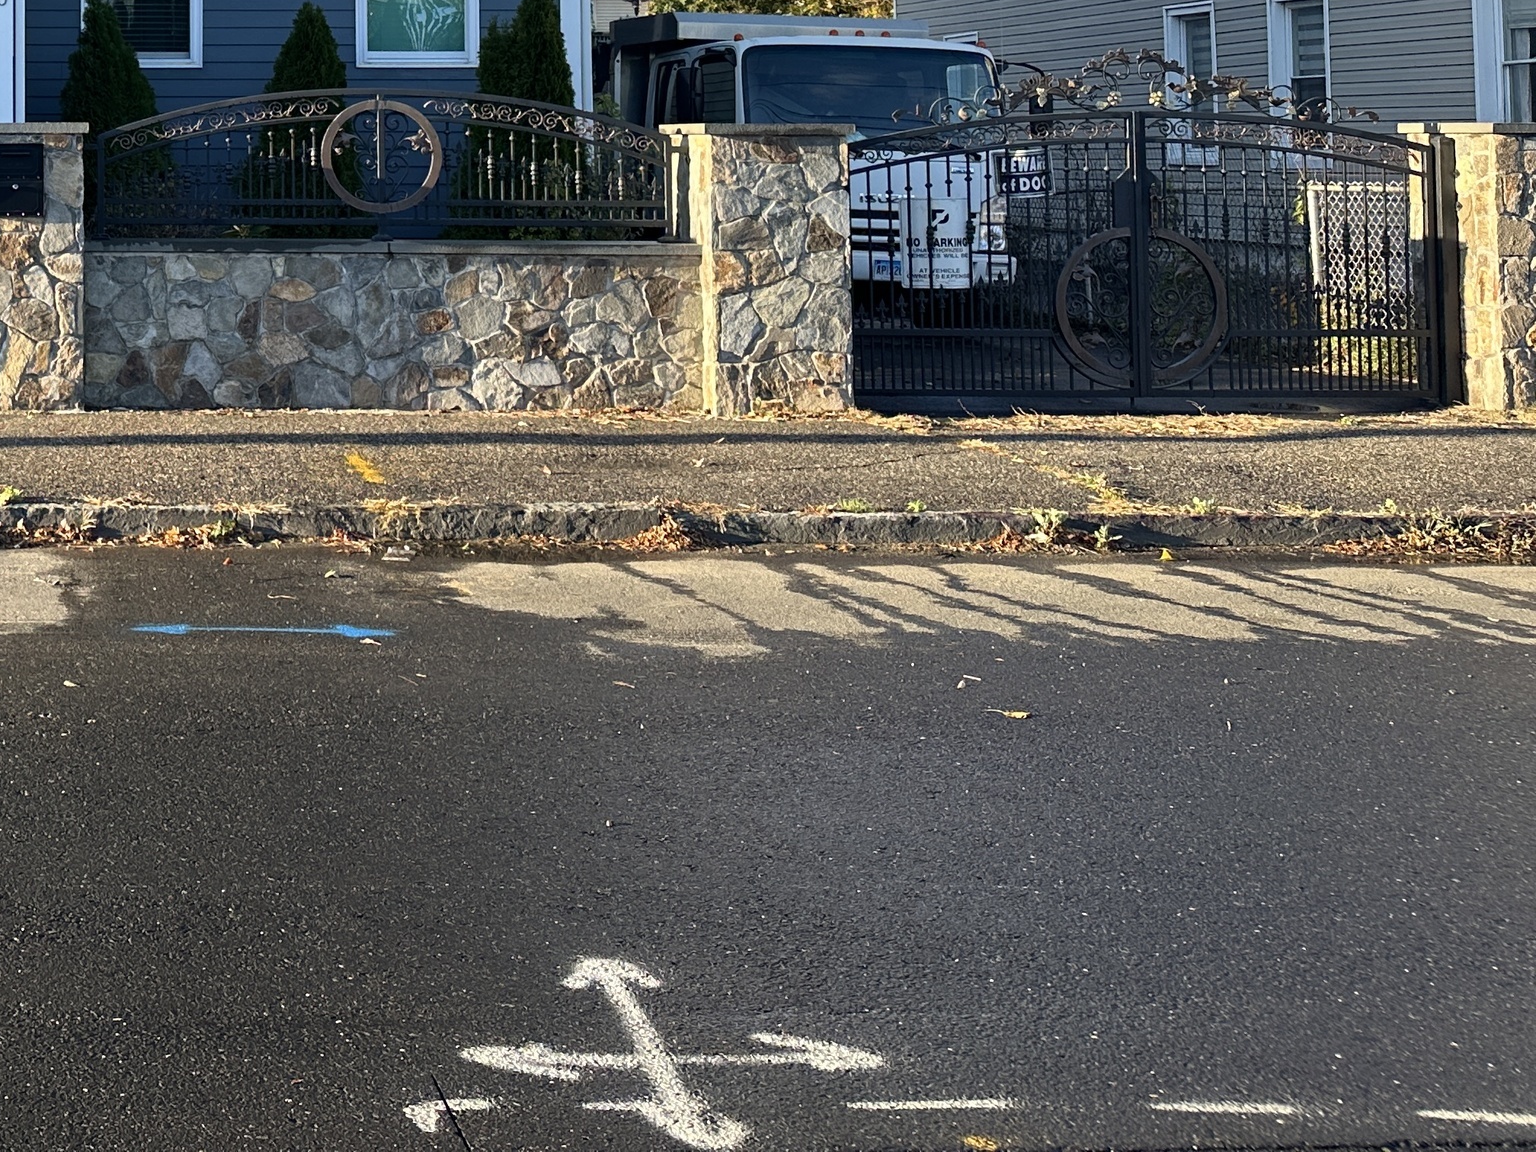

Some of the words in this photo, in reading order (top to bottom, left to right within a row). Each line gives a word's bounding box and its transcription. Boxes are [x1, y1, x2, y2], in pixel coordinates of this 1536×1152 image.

[859, 193, 914, 204] ISUZ
[906, 237, 920, 247] O
[927, 237, 970, 247] ARKING
